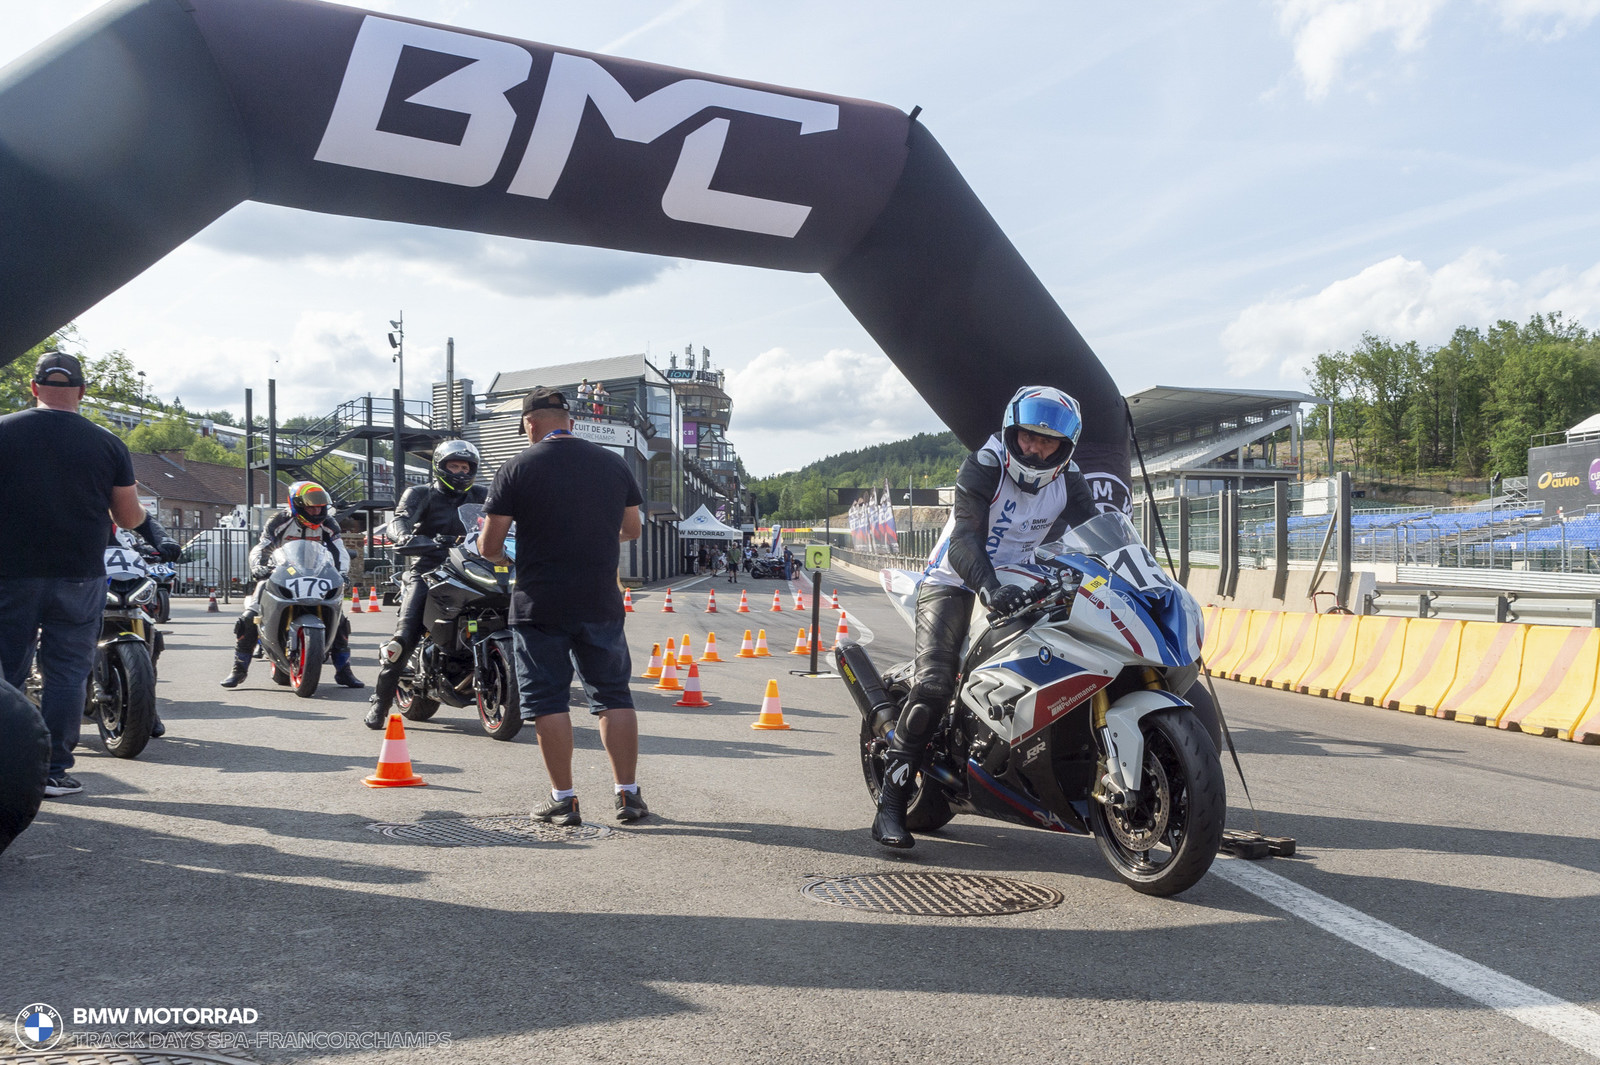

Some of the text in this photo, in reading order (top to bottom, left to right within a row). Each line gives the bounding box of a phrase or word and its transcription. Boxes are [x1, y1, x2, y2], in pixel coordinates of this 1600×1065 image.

[313, 14, 839, 238] BMC
[573, 423, 615, 435] CUIT DE SPA
[574, 432, 616, 441] NCORCHAMPS
[813, 551, 823, 565] C
[289, 578, 331, 598] 179
[1026, 741, 1046, 759] RR
